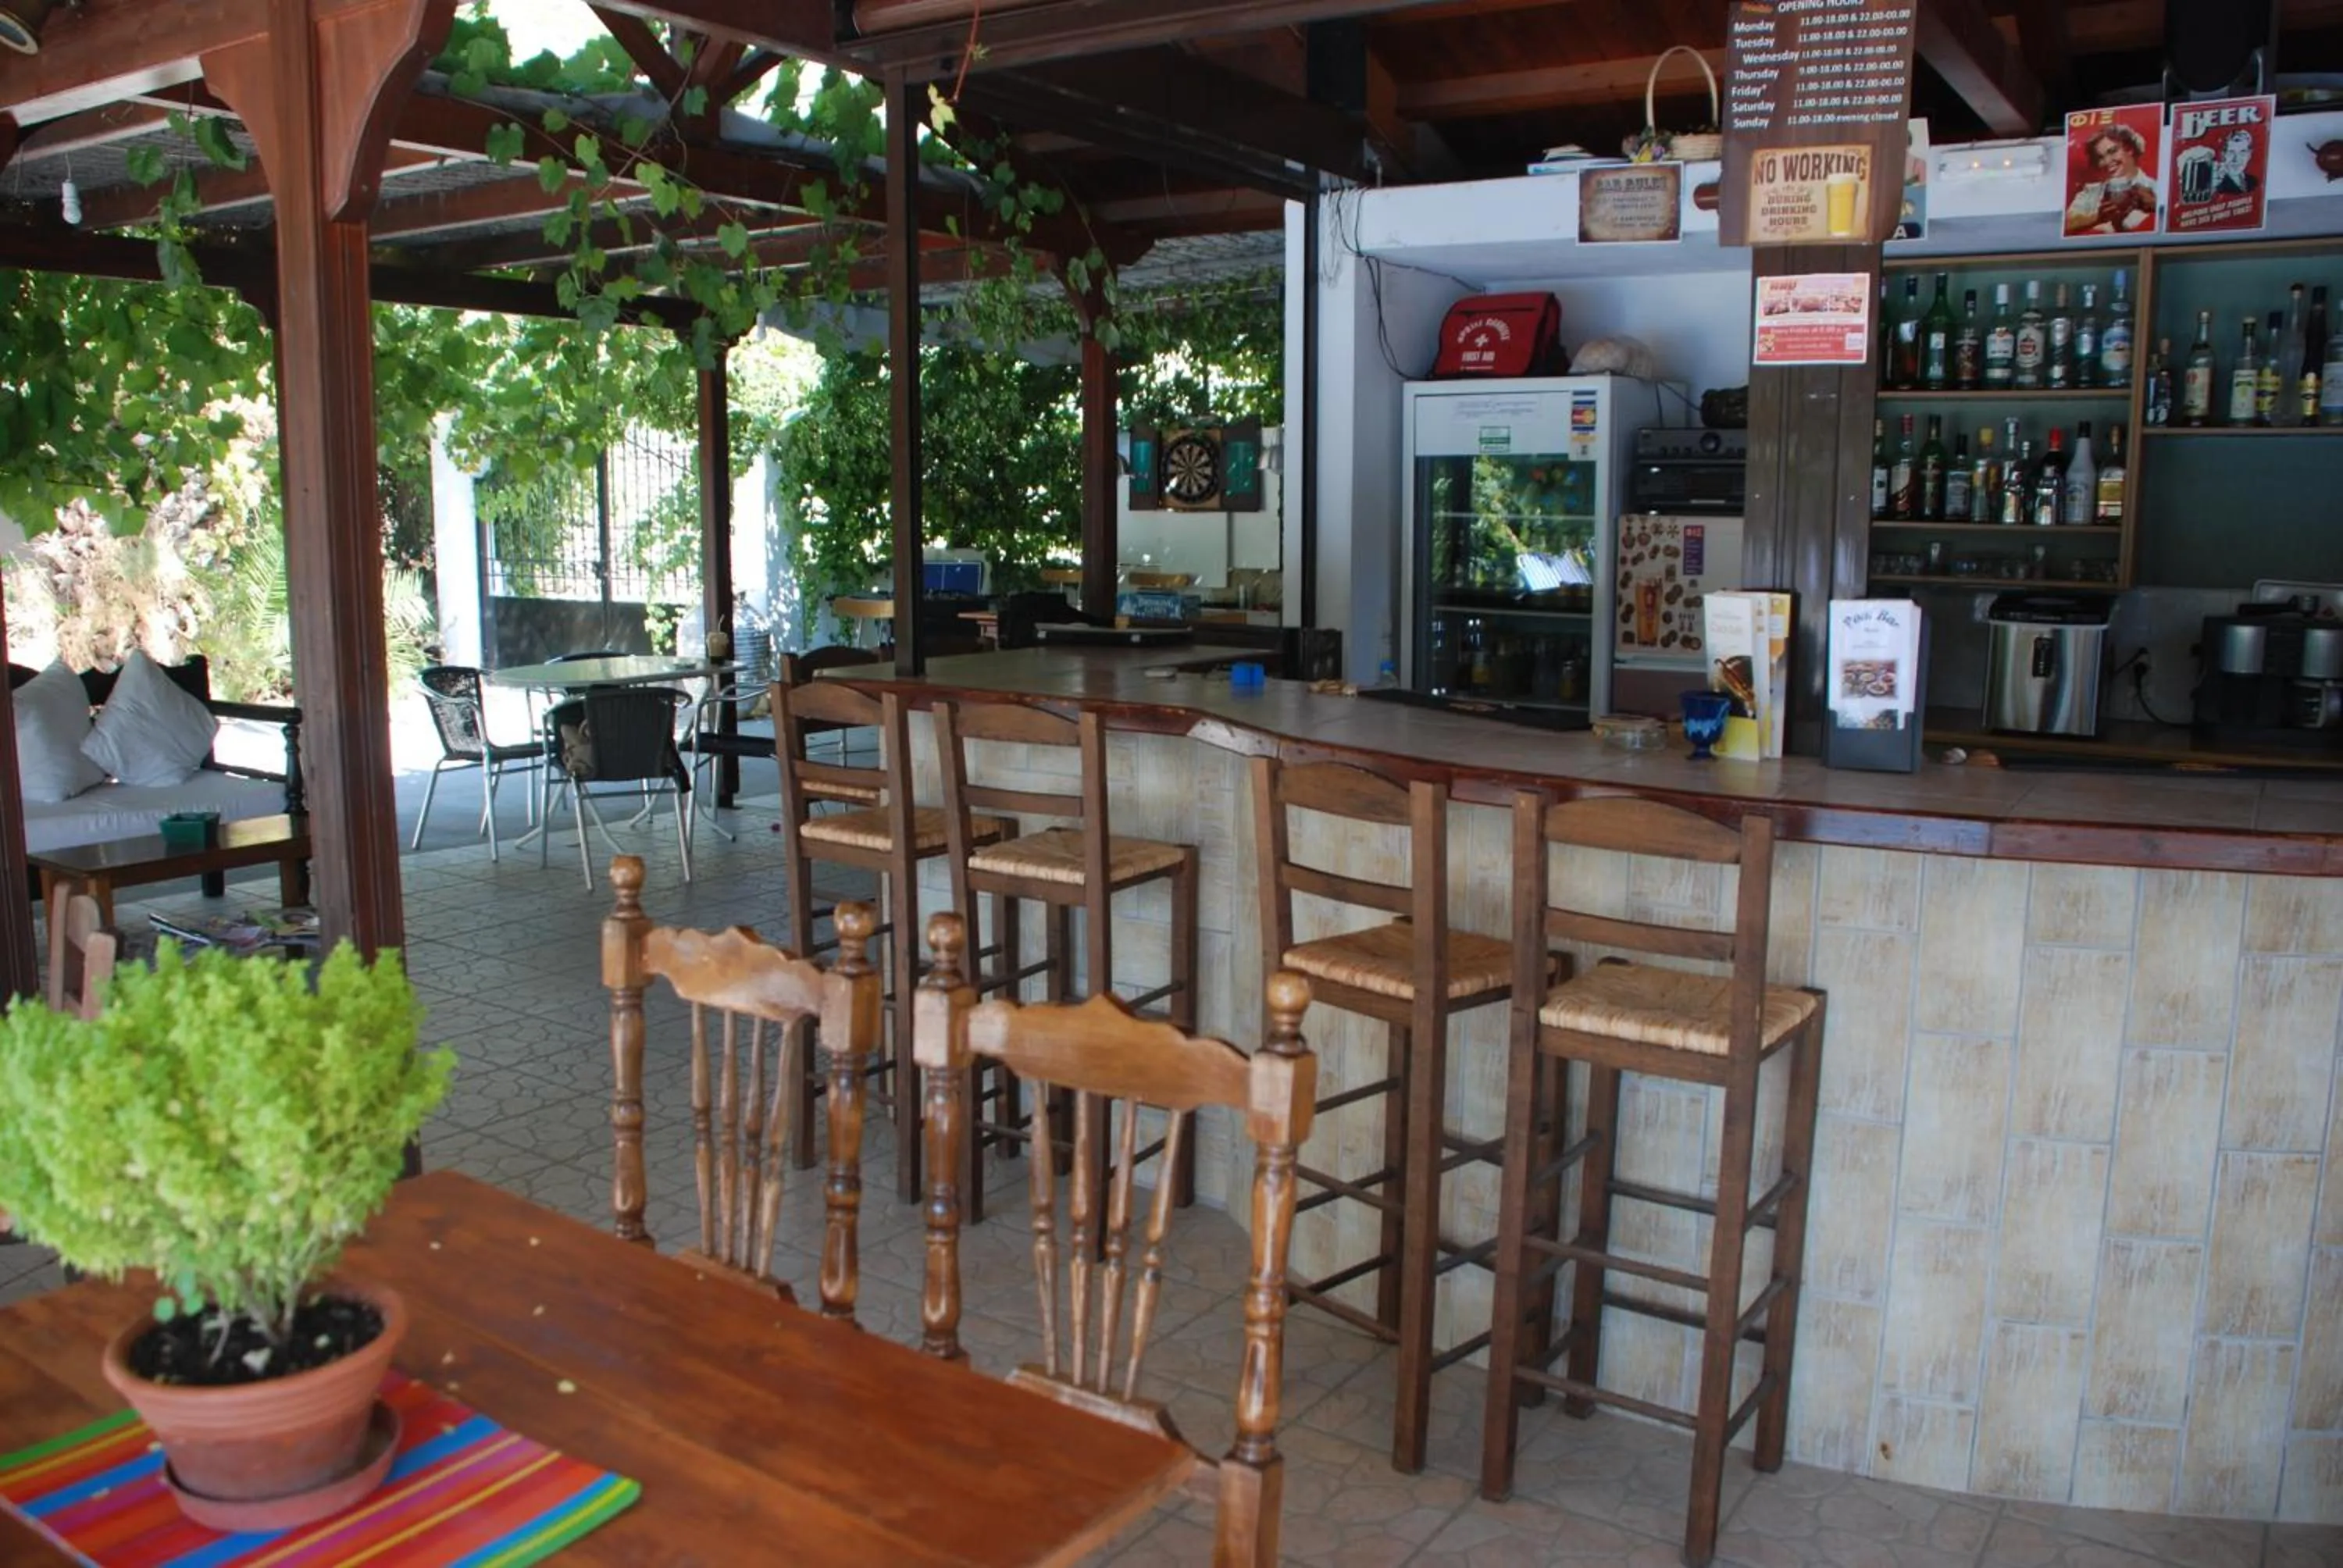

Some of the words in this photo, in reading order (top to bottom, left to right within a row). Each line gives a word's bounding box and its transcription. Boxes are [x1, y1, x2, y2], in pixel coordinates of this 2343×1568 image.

[1778, 0, 1824, 12] OPENING
[1734, 20, 1775, 33] Monday
[1735, 36, 1775, 48] Tuesday
[1742, 50, 1799, 65] Wednesday
[1735, 68, 1780, 80] Thursday
[1731, 100, 1775, 113] Saturday
[1733, 116, 1770, 129] Sunday
[2181, 105, 2263, 139] BEER
[1753, 157, 1777, 185] NO
[1782, 152, 1867, 182] WORKING
[1767, 194, 1811, 205] DURING
[1761, 205, 1817, 216] DRINKING
[1769, 216, 1808, 226] HOURS
[1482, 351, 1496, 362] AID
